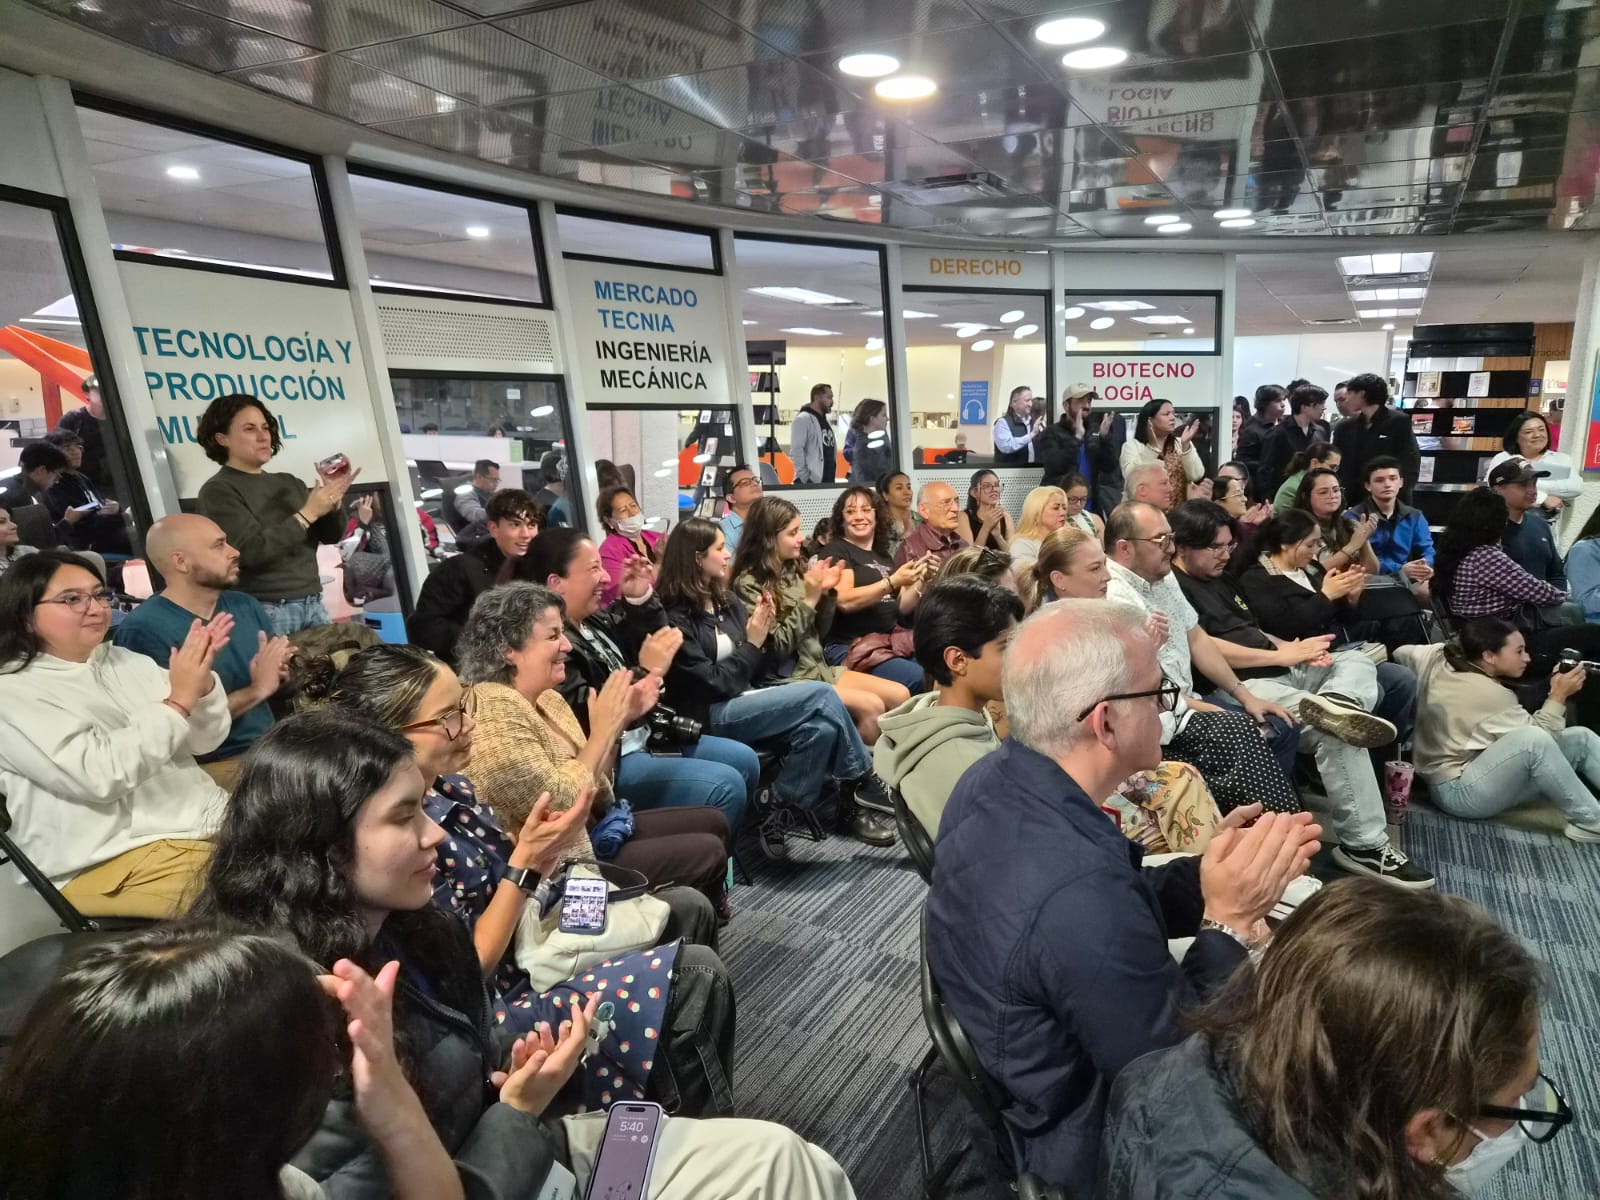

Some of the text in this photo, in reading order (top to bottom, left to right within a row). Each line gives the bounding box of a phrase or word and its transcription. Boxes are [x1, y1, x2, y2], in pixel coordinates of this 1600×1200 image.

[930, 258, 1021, 276] DERECHO
[594, 280, 698, 308] MERCADO
[597, 309, 675, 333] TECNIA
[133, 326, 352, 365] TECNOLOGÍA Y
[595, 340, 712, 364] INGENIERÍA
[600, 365, 708, 391] MECÁNICA
[1093, 362, 1195, 378] BIOTECNO
[145, 369, 346, 401] PRODUCCIÓN
[619, 1120, 644, 1133] 5:40
